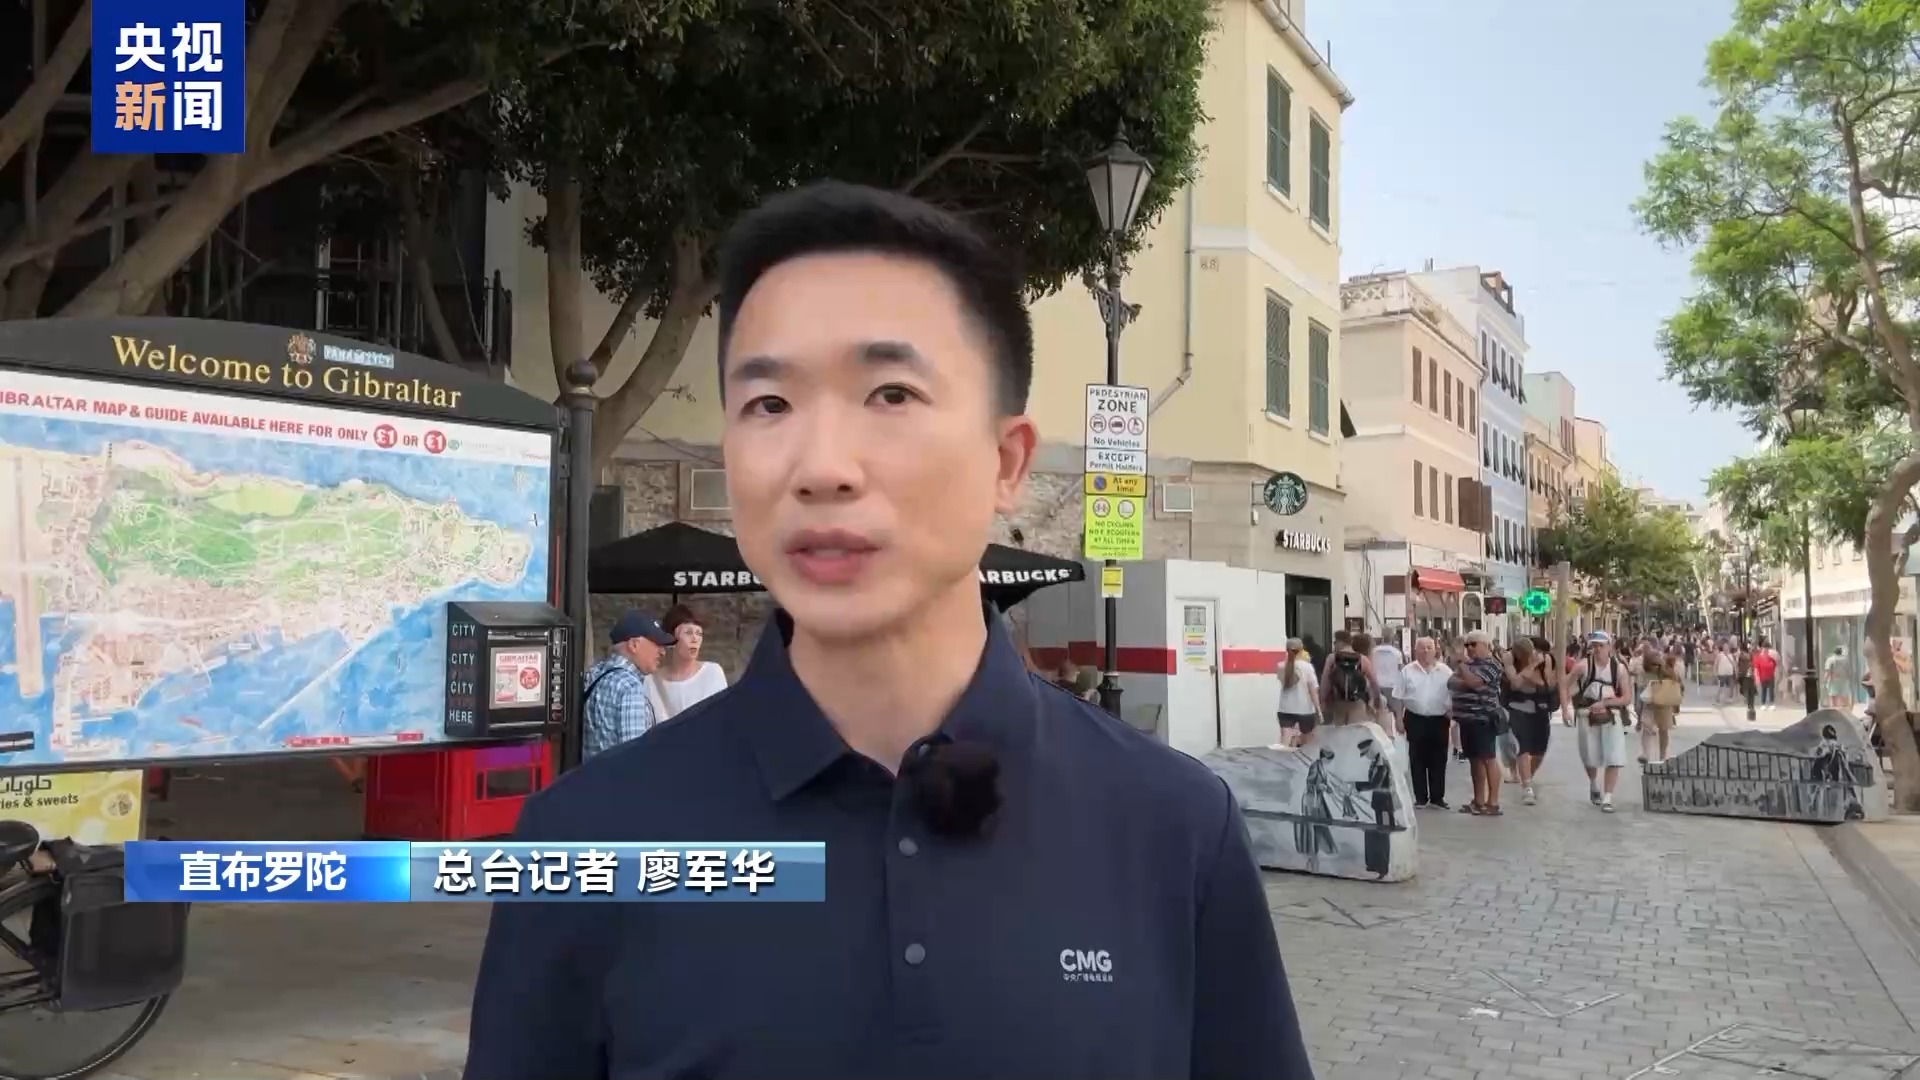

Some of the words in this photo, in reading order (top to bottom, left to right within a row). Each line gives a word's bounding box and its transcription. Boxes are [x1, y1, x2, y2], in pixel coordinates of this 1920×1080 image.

[111, 335, 272, 384] Welcome
[281, 363, 313, 389] to
[323, 367, 462, 408] Gibraltar
[1090, 388, 1146, 400] PEDESTRIAN
[1098, 399, 1137, 413] ZONE
[93, 401, 128, 416] MAP
[130, 405, 141, 418] &
[145, 407, 188, 423] GUIDE
[192, 412, 266, 430] AVAILABLE
[269, 419, 304, 434] HERE
[308, 424, 333, 437] FOR
[338, 427, 368, 441] ONLY
[403, 434, 419, 446] OR
[1094, 437, 1106, 446] No
[1108, 438, 1140, 448] Vehicles
[1098, 452, 1136, 463] EXCEPT
[1283, 529, 1331, 553] STARBUCKS
[452, 624, 476, 637] CITY
[451, 653, 475, 666] CITY
[450, 681, 474, 694] CITY
[449, 709, 473, 723] HERE
[23, 797, 33, 808] &
[37, 793, 79, 806] sweets
[1060, 948, 1112, 972] CMG
